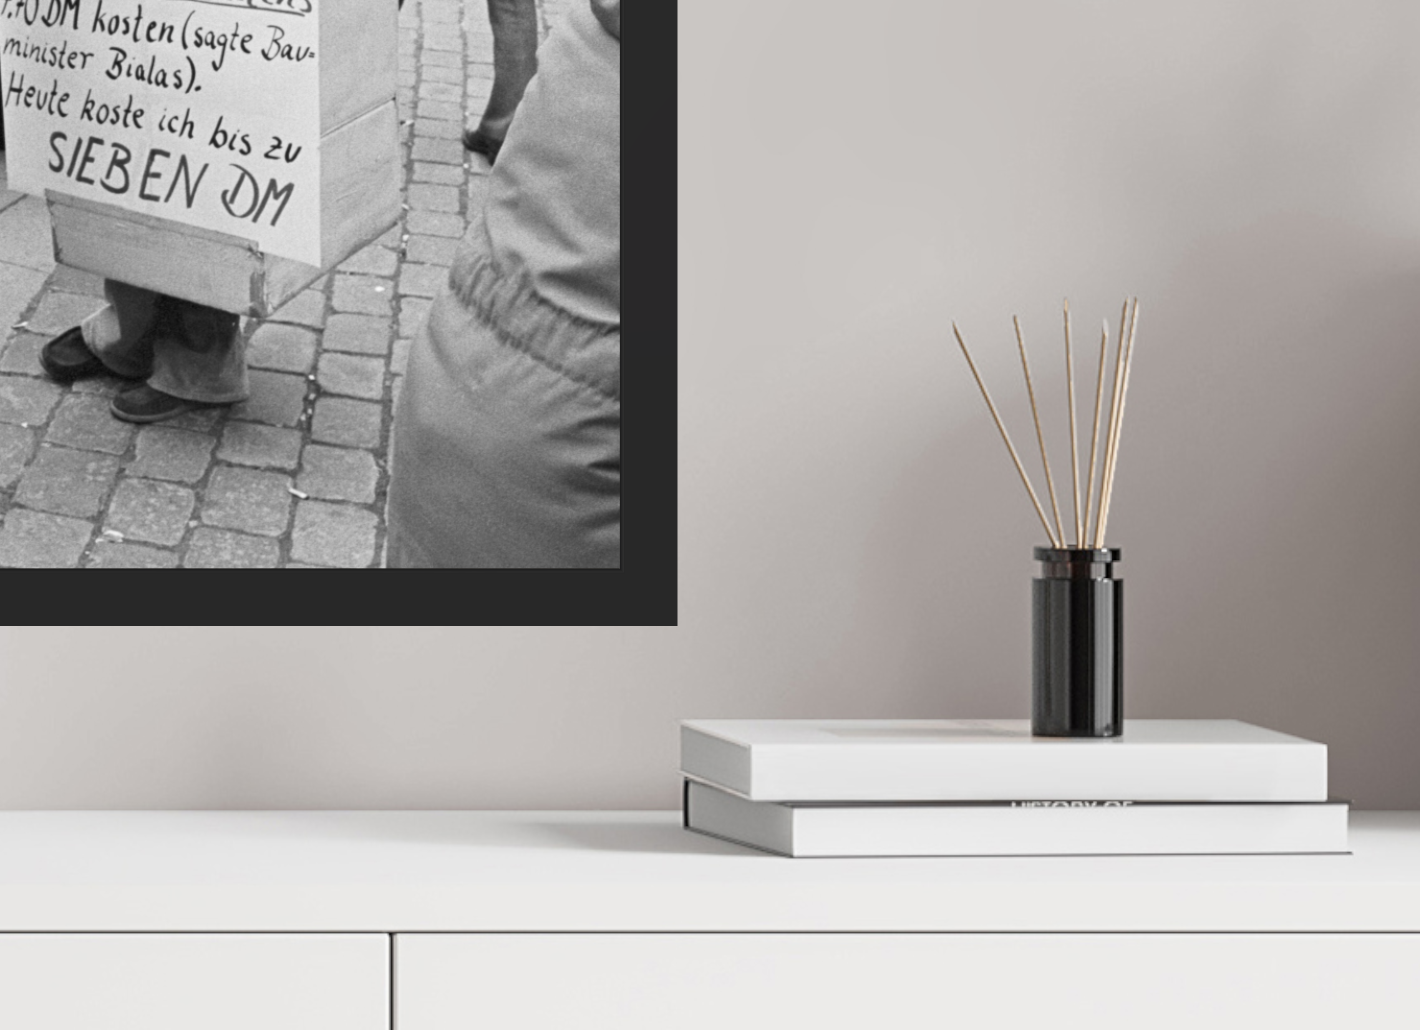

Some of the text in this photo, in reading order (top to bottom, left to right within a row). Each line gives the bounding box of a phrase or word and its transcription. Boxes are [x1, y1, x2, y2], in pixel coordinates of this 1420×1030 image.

[3, 37, 202, 94] minister Bialas).
[92, 0, 175, 44] kosten
[181, 10, 253, 72] (sagte
[5, 71, 302, 164] Heute koste ich bis zu
[47, 131, 295, 227] SIEBEN DM
